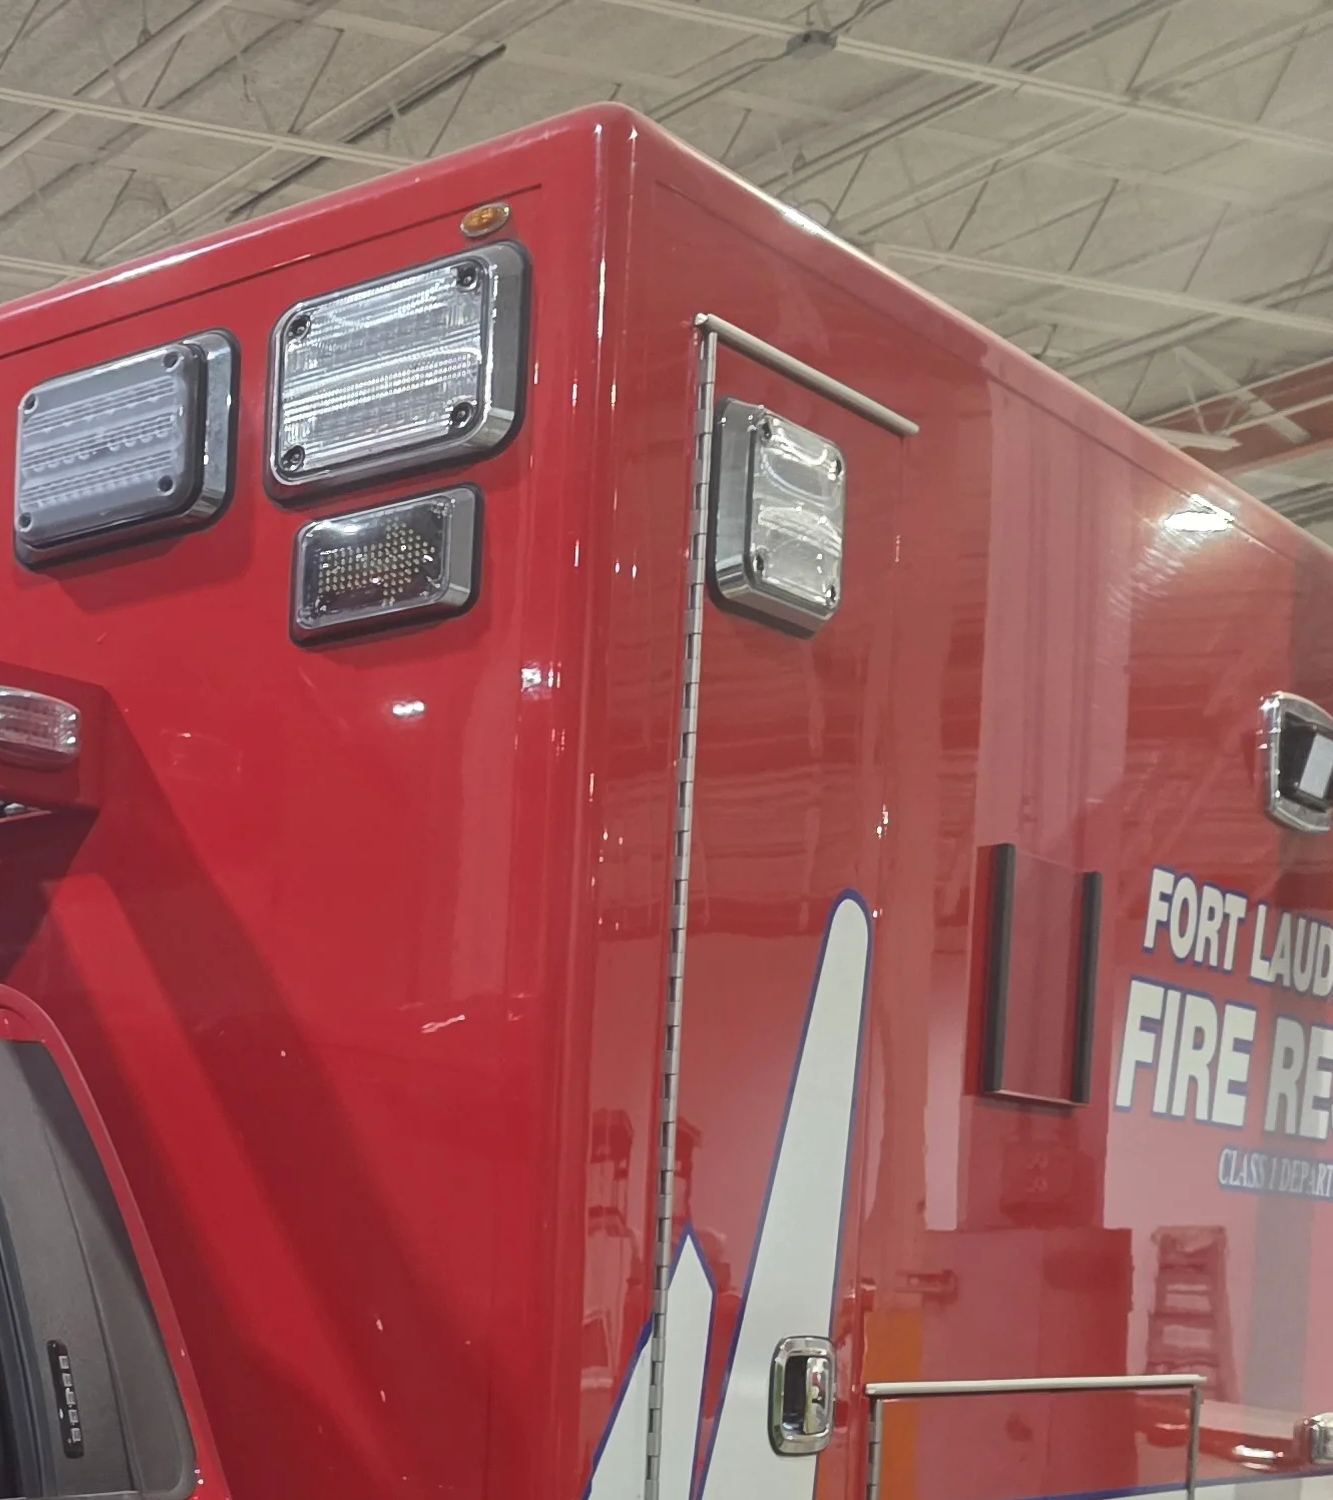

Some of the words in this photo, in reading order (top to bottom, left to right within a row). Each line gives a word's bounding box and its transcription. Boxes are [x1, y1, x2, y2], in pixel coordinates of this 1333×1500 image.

[1142, 866, 1247, 971] FORT
[1249, 903, 1333, 997] LAUD
[1115, 979, 1257, 1128] FIRE
[1264, 1016, 1333, 1139] RE
[1218, 1147, 1267, 1190] CLASS
